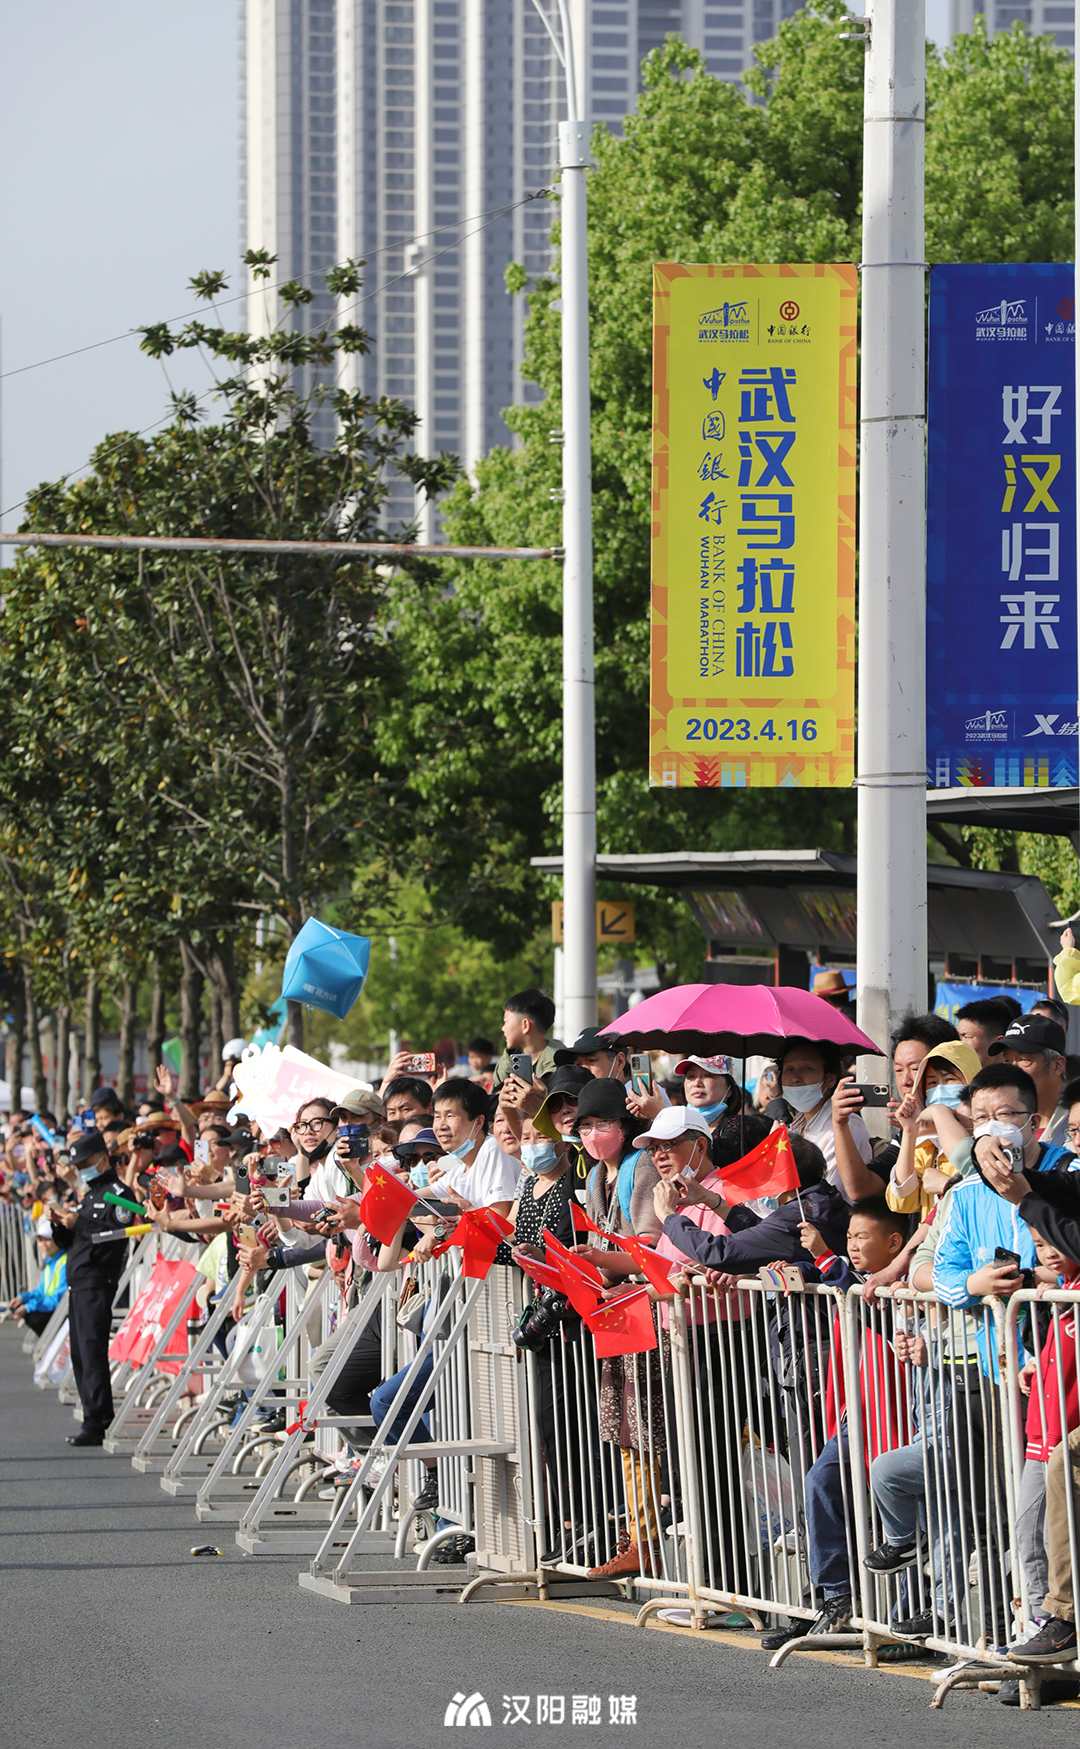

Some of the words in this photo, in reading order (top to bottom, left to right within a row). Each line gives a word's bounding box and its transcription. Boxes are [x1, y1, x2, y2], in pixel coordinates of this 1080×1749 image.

[698, 329, 749, 339] 武汉马拉松
[976, 327, 1027, 337] 武汉马拉松
[736, 367, 796, 676] 武汉马拉松
[1000, 386, 1061, 649] 好汉归来
[700, 536, 709, 589] WUHAN
[713, 535, 725, 583] BANK
[713, 590, 725, 613] OF
[700, 598, 709, 676] MARATHON
[712, 619, 725, 676] CHINA
[686, 719, 818, 741] 2023.4.16
